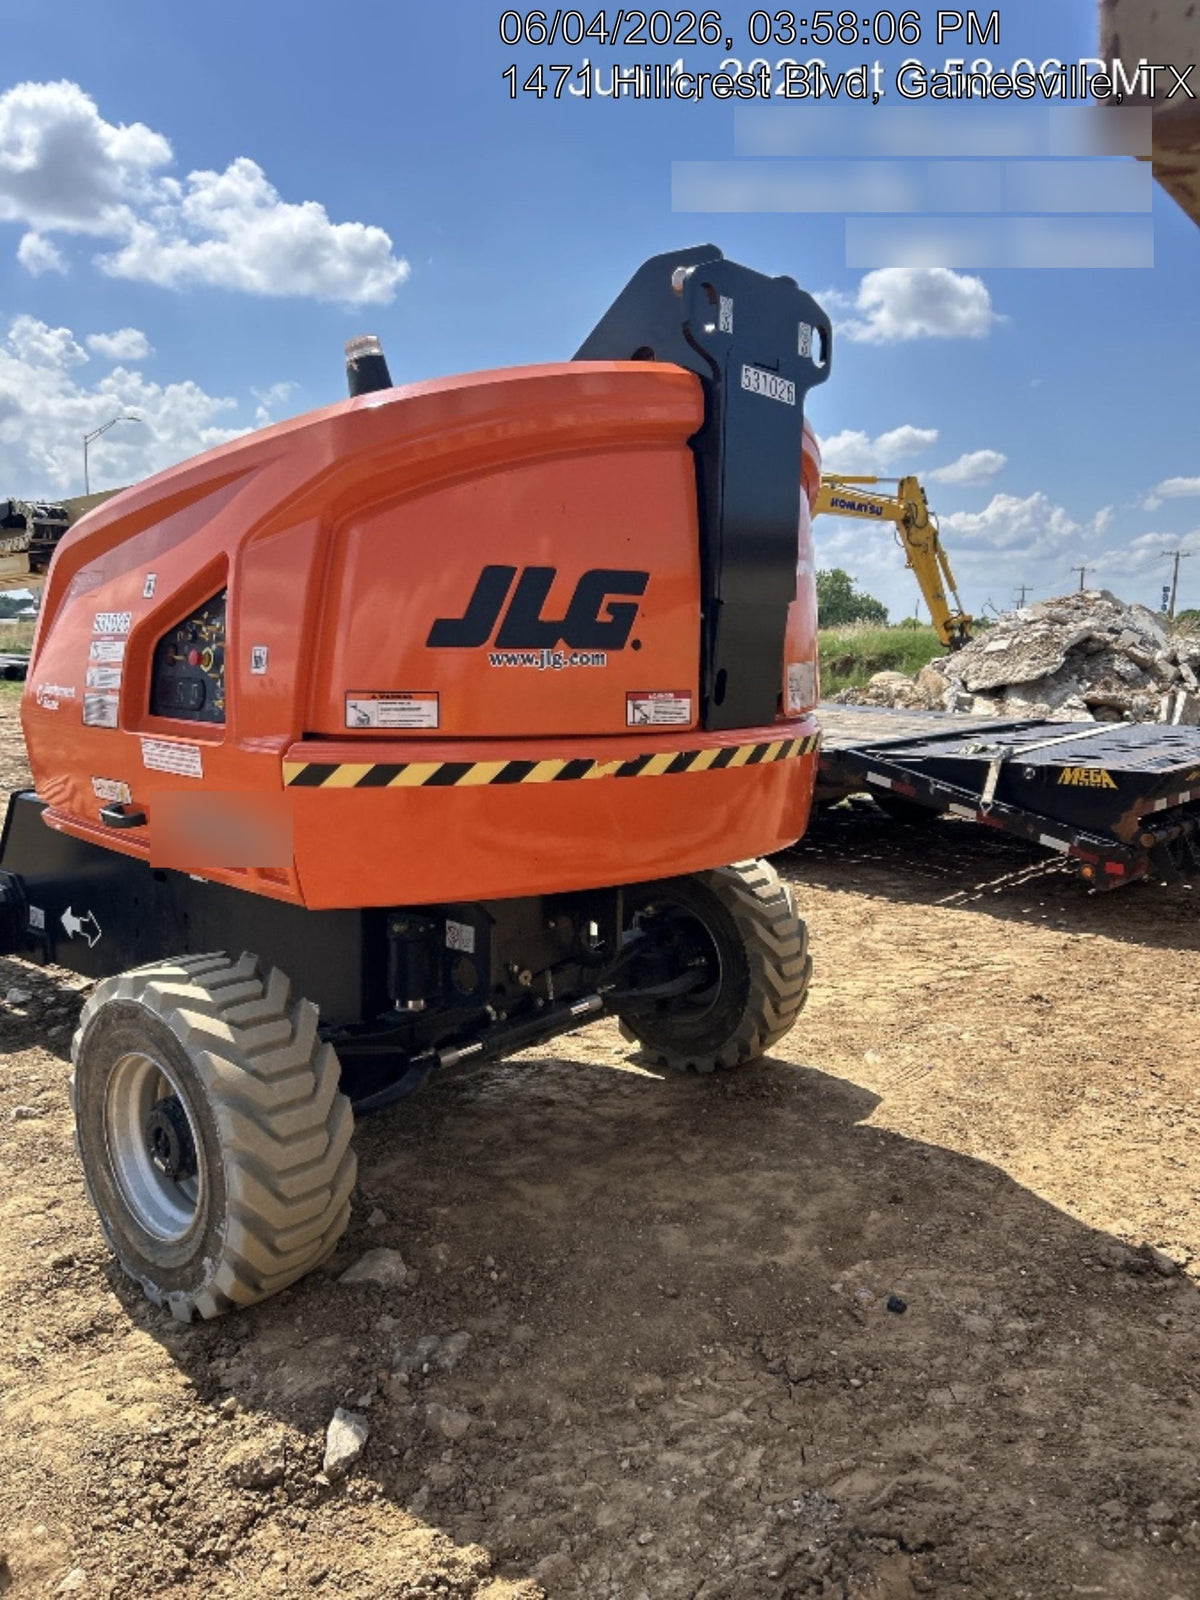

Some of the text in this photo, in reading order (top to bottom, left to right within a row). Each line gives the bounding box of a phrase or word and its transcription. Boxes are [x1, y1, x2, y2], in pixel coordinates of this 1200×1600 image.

[742, 367, 794, 403] 531026
[488, 650, 607, 670] www.jlg.com
[1057, 767, 1119, 789] MEGA
